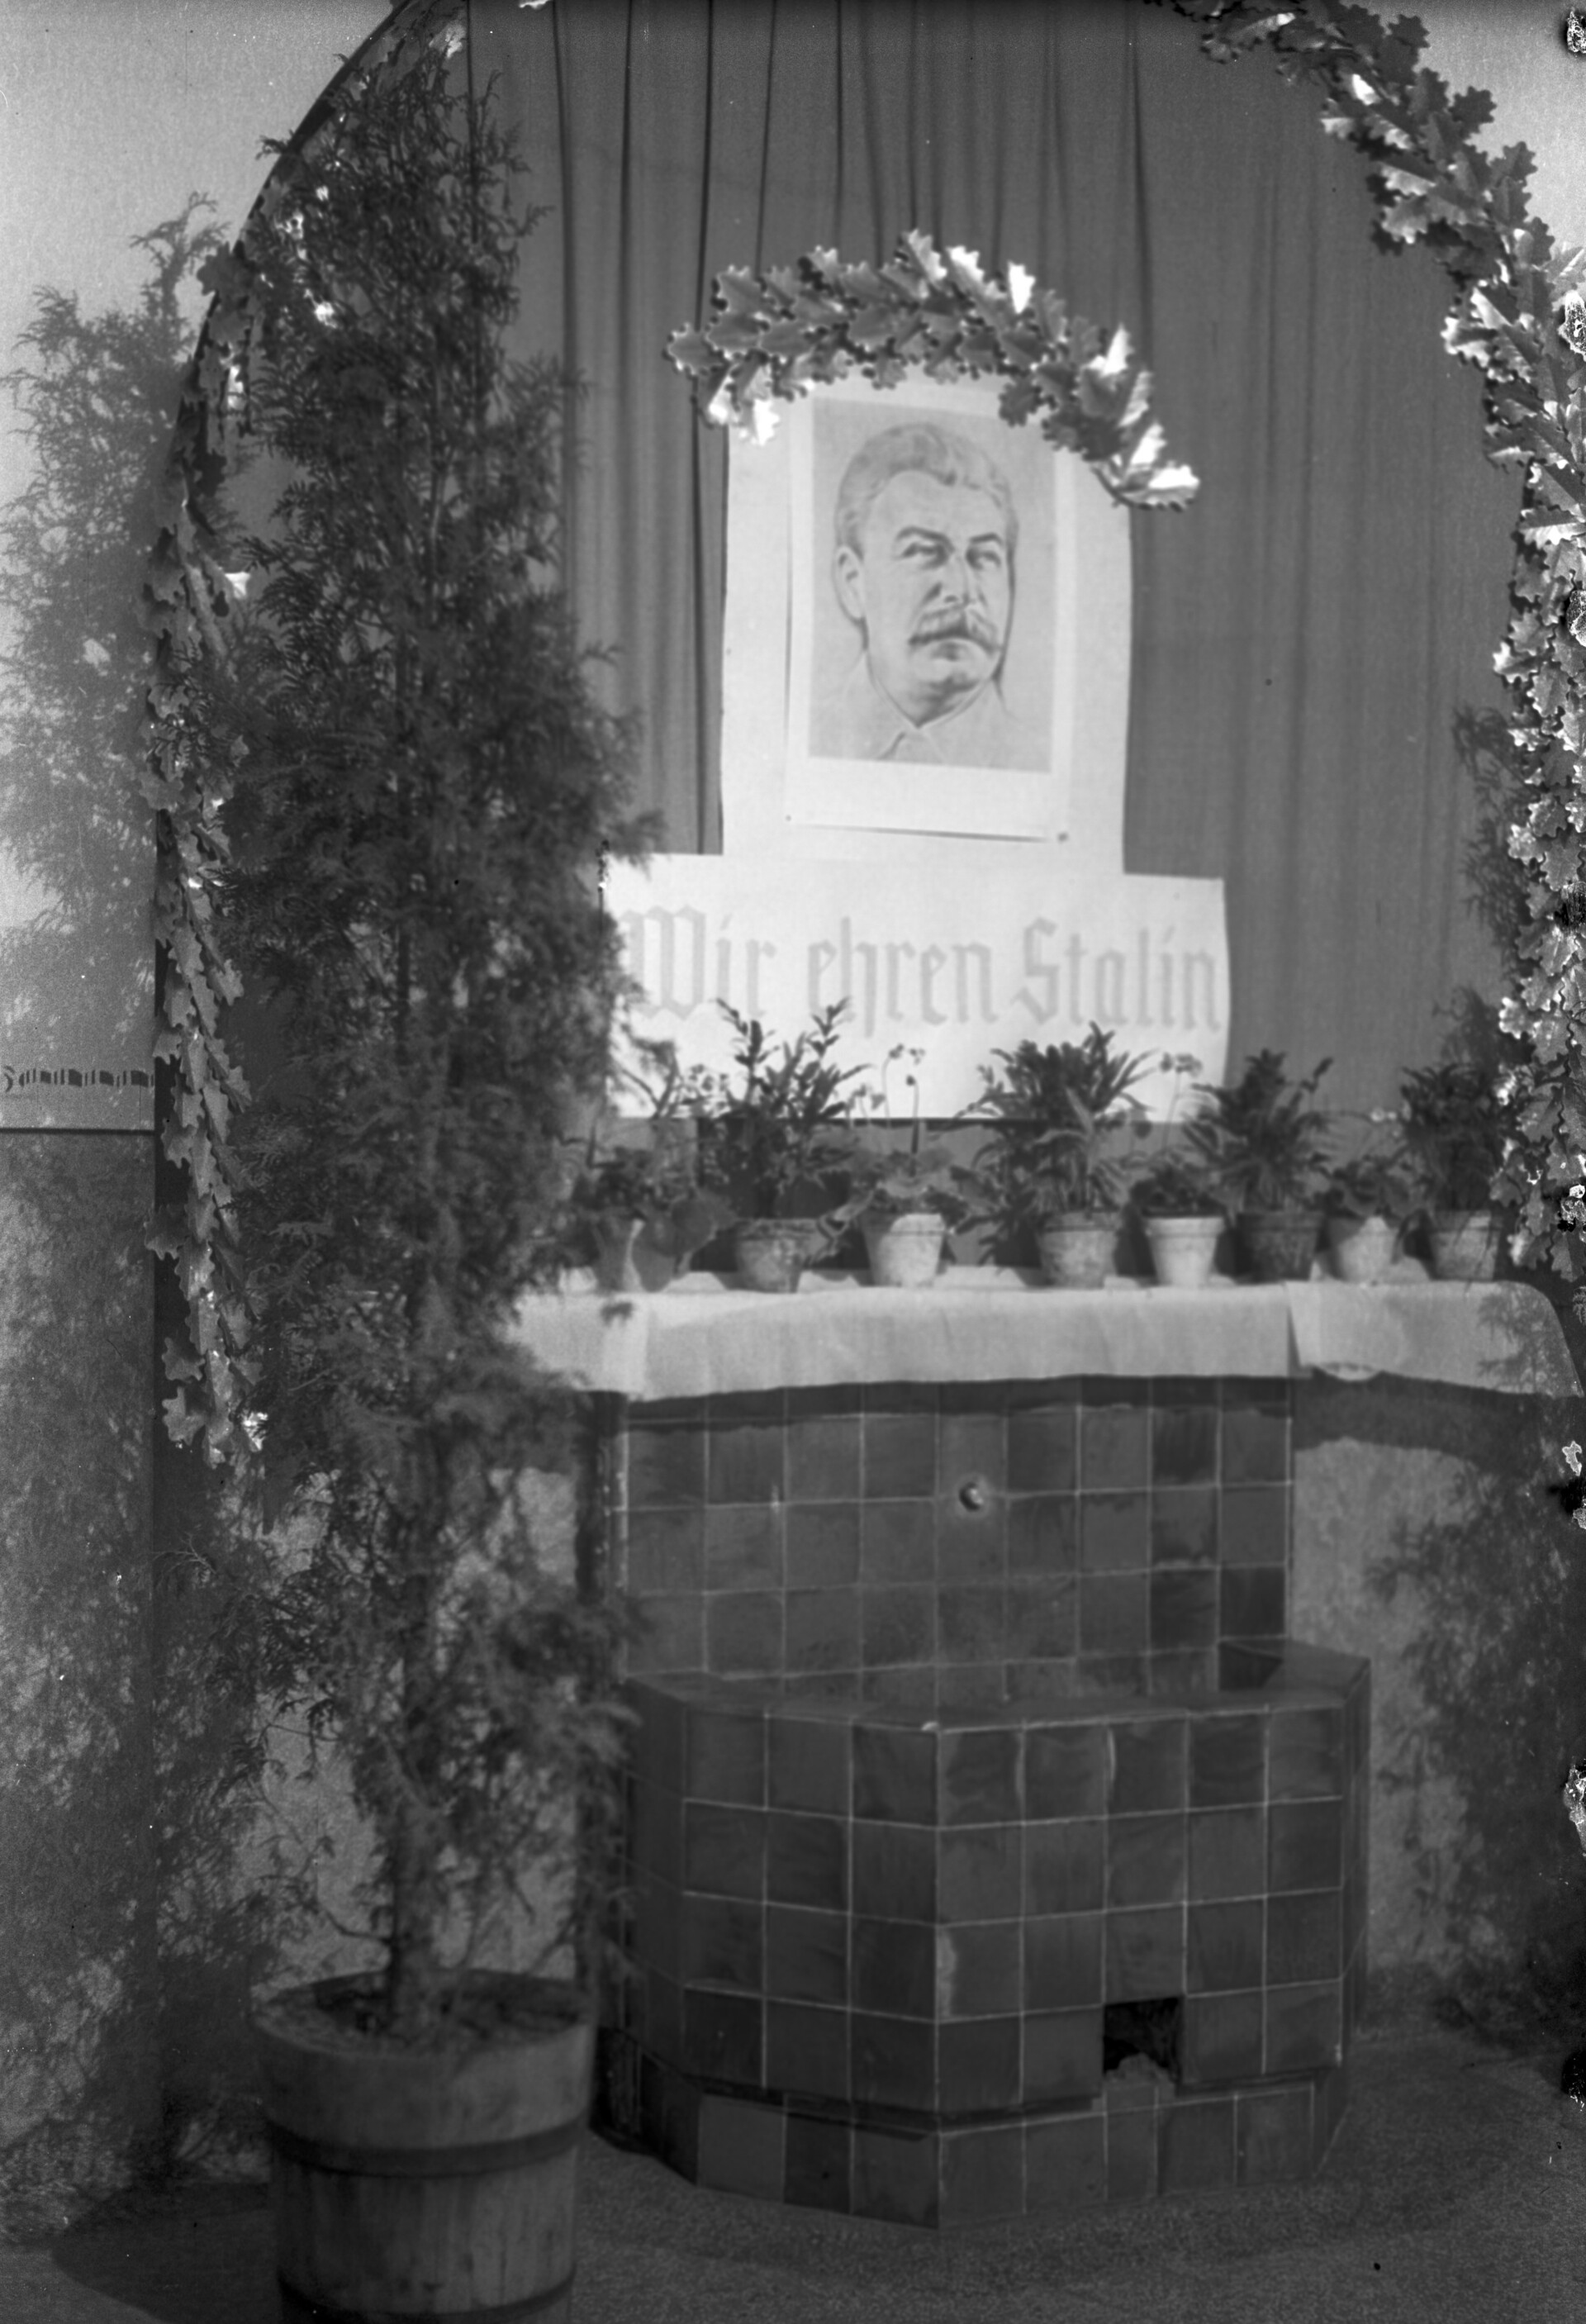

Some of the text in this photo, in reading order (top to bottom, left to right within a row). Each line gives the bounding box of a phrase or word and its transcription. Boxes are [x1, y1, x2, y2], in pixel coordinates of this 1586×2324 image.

[620, 905, 1222, 1038] Wir ehren Stalin
